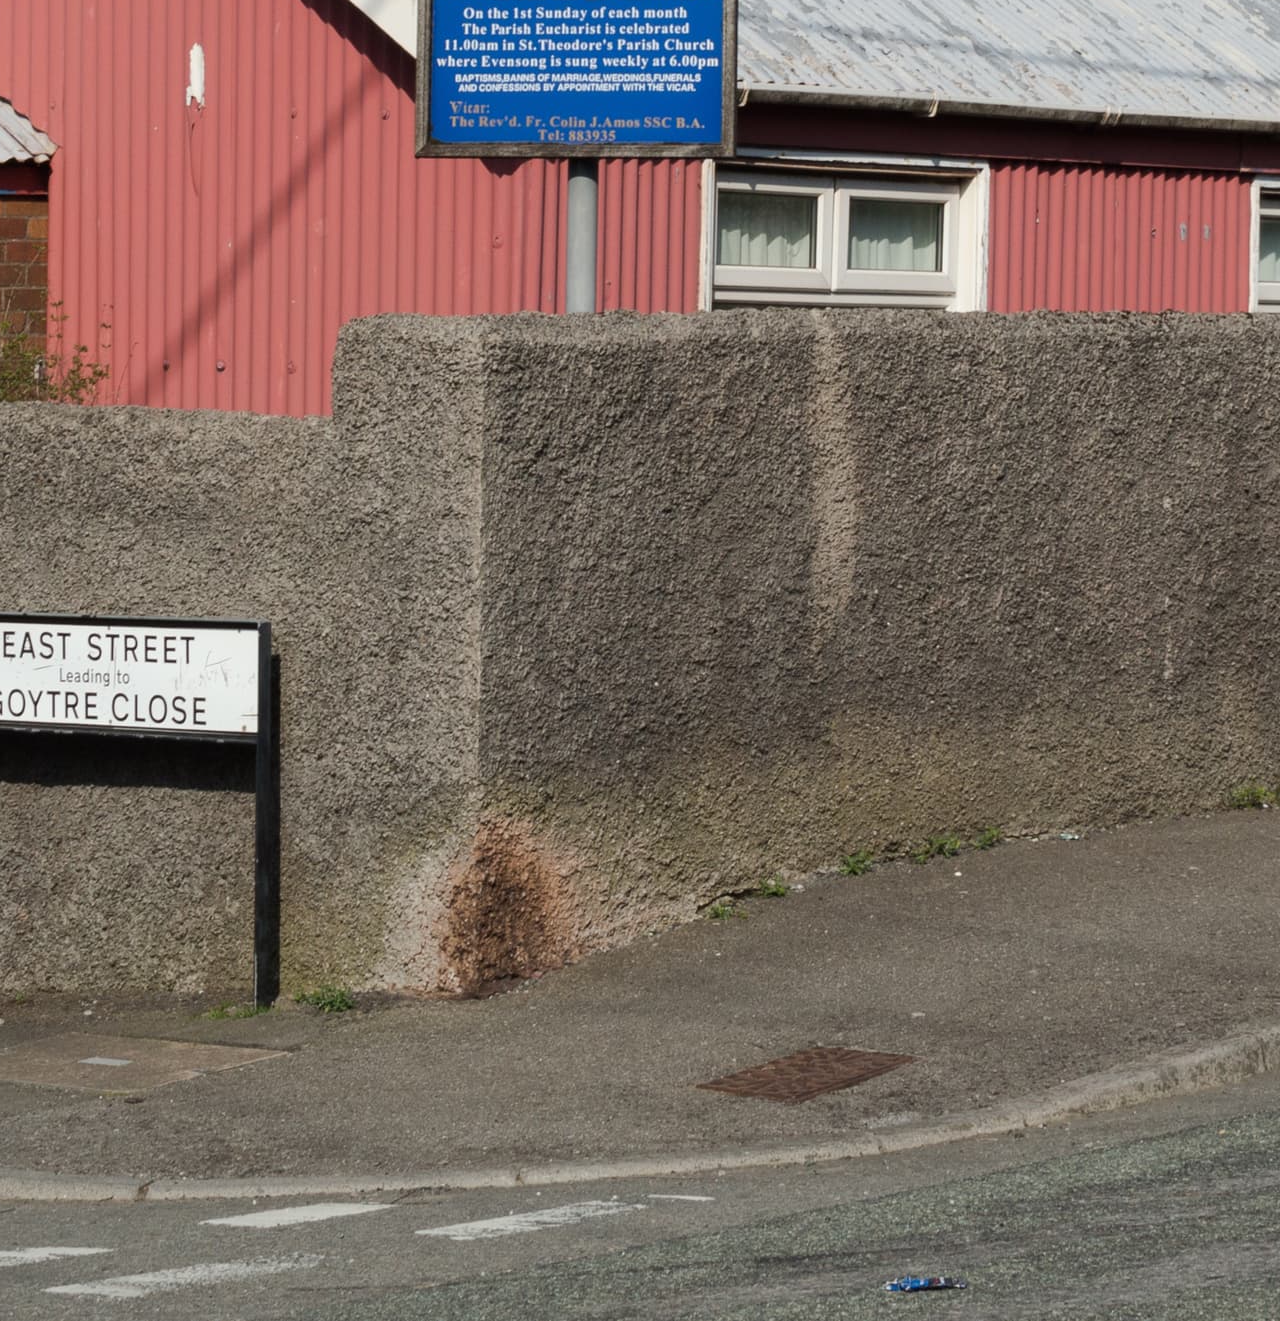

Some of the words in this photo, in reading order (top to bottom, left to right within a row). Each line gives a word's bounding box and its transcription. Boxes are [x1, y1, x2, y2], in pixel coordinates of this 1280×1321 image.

[464, 8, 483, 18] On
[488, 8, 508, 18] the
[514, 8, 531, 18] 1st
[536, 7, 587, 20] Sunday
[592, 7, 605, 18] of
[609, 7, 639, 18] each
[644, 7, 687, 18] month
[462, 24, 486, 34] The
[492, 24, 530, 34] Parish
[536, 24, 600, 34] Eucharist
[606, 23, 615, 34] is
[620, 23, 689, 34] celebrated
[446, 40, 498, 50] 11.00am
[503, 40, 514, 50] in
[618, 39, 659, 50] Parish
[665, 39, 713, 50] Church
[437, 56, 477, 67] where
[482, 56, 546, 69] Evensong
[551, 55, 561, 66] is
[566, 58, 597, 69] sung
[603, 55, 648, 69] weekly
[653, 57, 665, 66] at
[670, 56, 718, 69] 6.00pm
[539, 74, 549, 82] OF
[458, 83, 476, 92] AND
[479, 84, 540, 92] CONFESSIONS
[543, 84, 555, 92] BY
[557, 83, 619, 92] APPOINTMENT
[622, 83, 645, 92] WITH
[647, 83, 664, 91] THE
[666, 83, 696, 91] VICAR.
[450, 101, 489, 113] Vicar:
[450, 117, 474, 127] The
[479, 116, 520, 127] Rev'd.
[526, 117, 545, 127] Fr.
[550, 117, 585, 128] Colin
[644, 117, 671, 128] SSC
[676, 118, 704, 128] B.A.
[538, 130, 564, 141] Tel:
[569, 130, 616, 141] 883935
[4, 632, 70, 659] EAST
[88, 634, 194, 663] STREET
[59, 668, 110, 686] Leading
[116, 671, 130, 685] to
[112, 694, 207, 725] CLOSE
